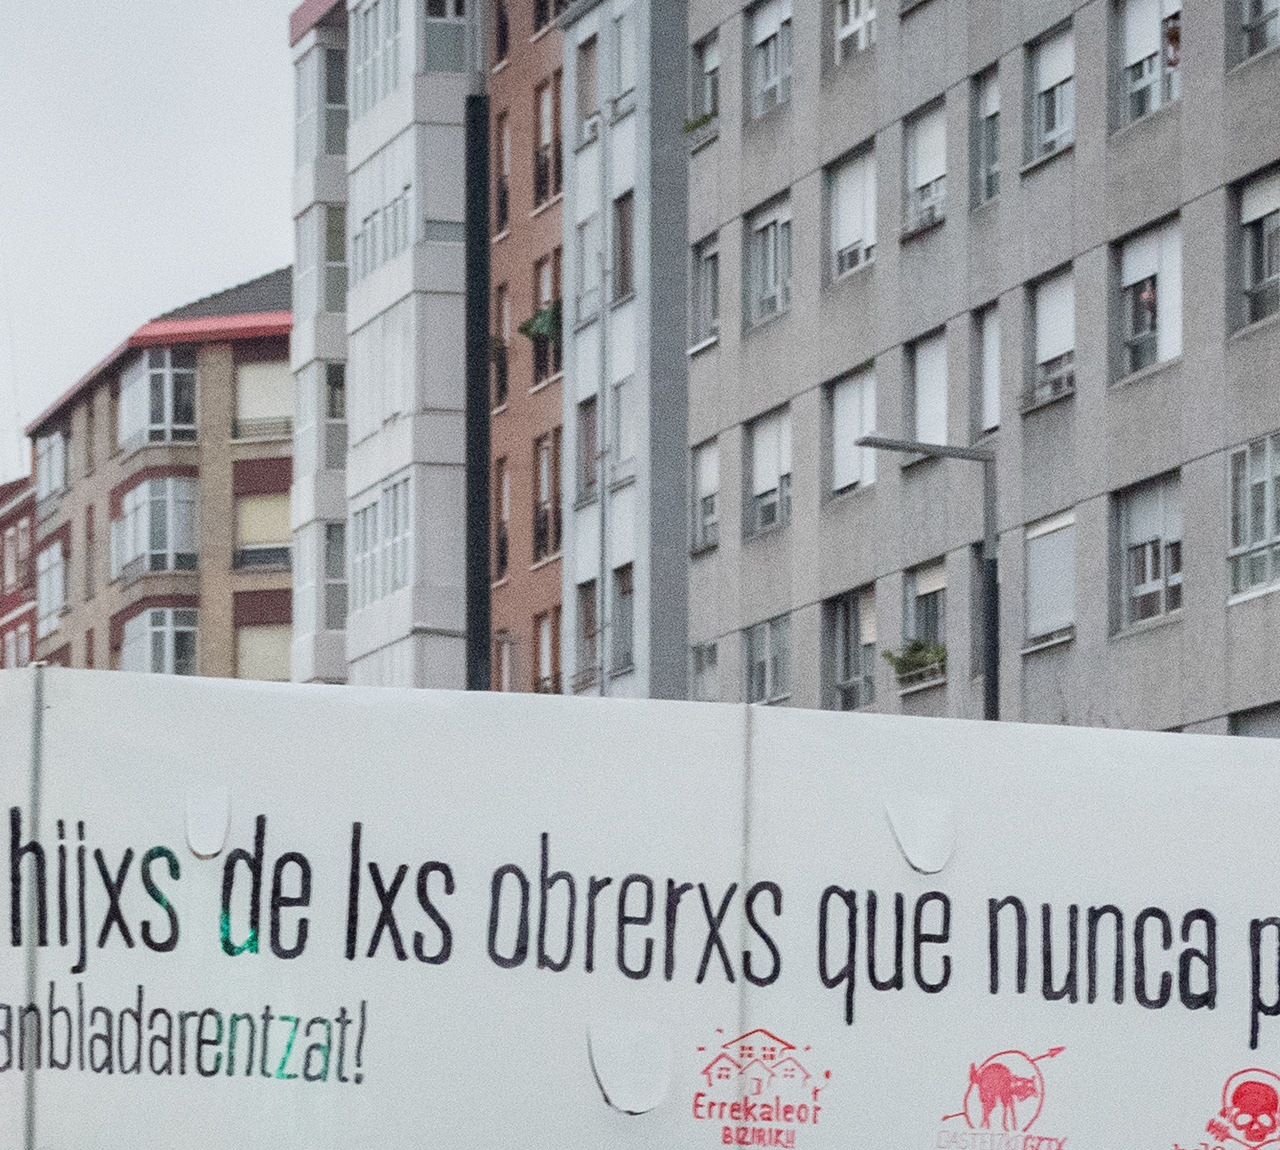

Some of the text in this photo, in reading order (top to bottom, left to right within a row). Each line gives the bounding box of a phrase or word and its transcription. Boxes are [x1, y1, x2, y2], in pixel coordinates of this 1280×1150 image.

[9, 806, 180, 974] hijxs
[220, 814, 313, 960] de
[344, 822, 455, 965] lxs
[487, 832, 782, 987] obrerxs
[818, 885, 952, 1026] que
[987, 895, 1218, 1010] nunca
[692, 1091, 821, 1125] Errekaleor
